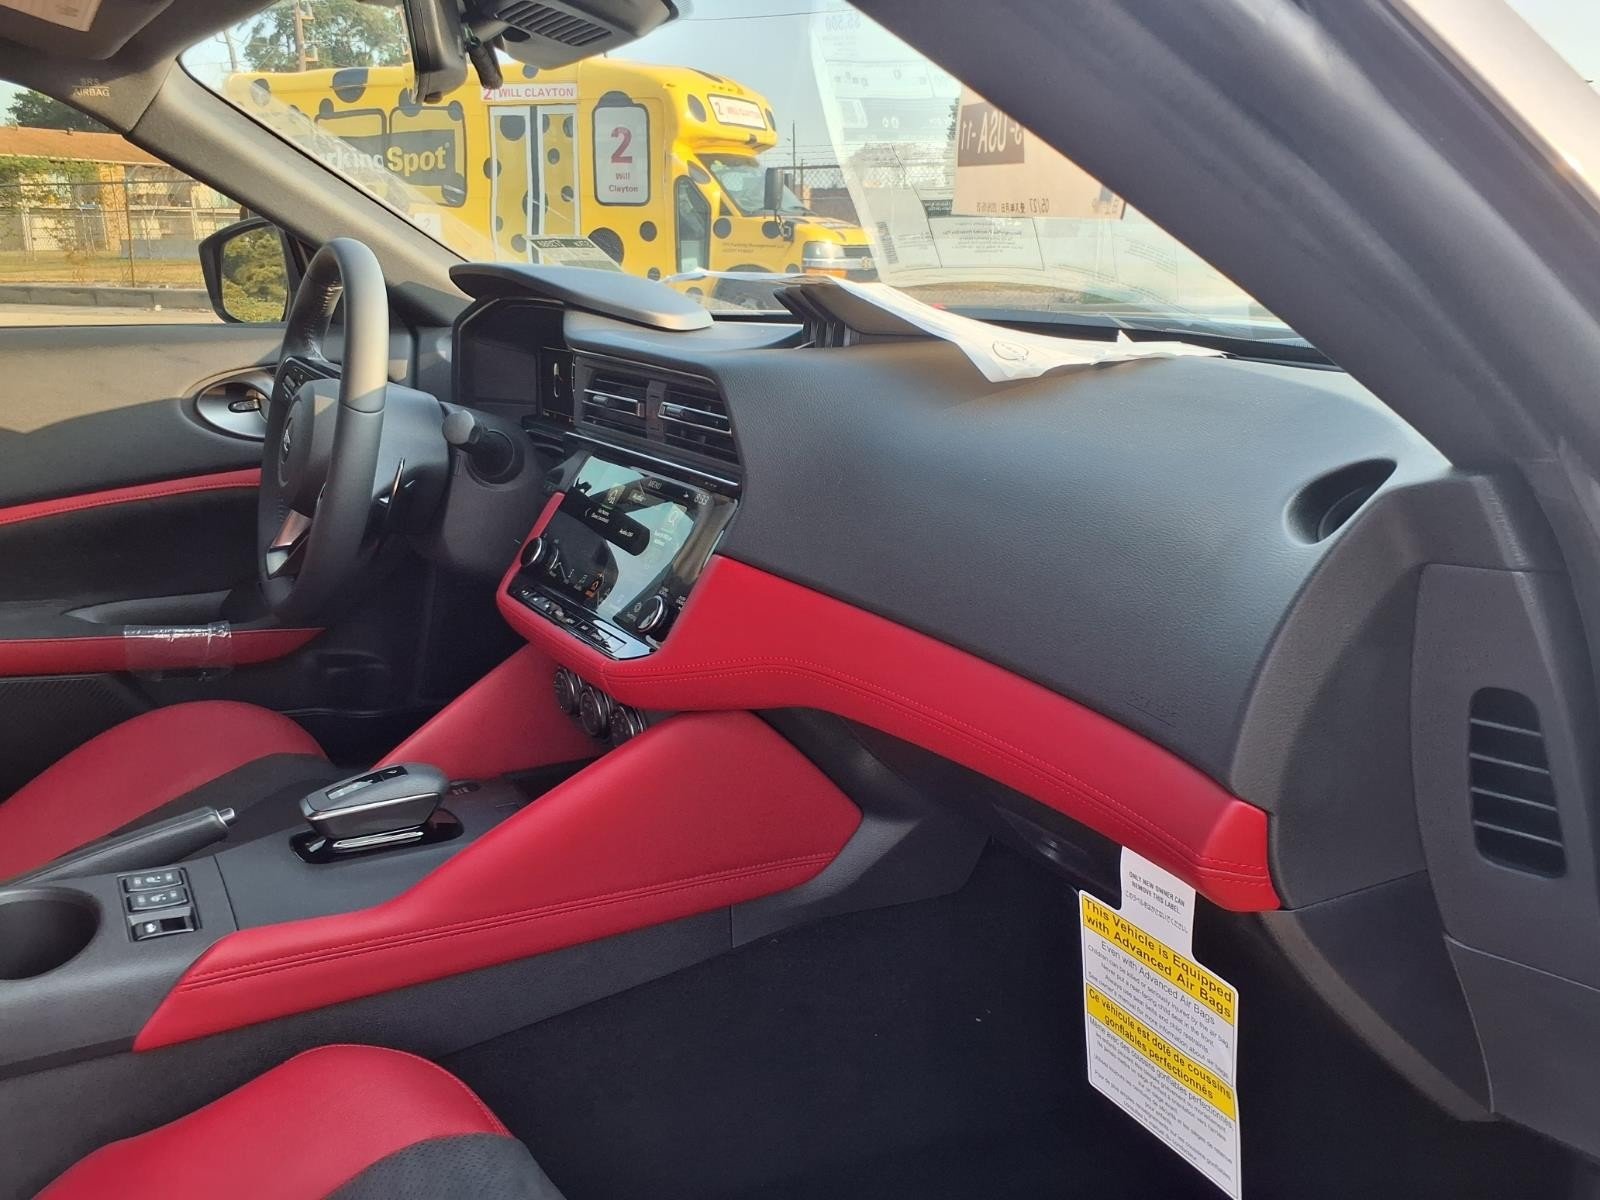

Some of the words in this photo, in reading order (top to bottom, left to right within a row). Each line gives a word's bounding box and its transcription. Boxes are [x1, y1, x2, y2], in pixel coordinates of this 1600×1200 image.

[72, 88, 110, 96] AIRBAG
[499, 88, 521, 98] WILL
[524, 87, 574, 98] CLAYTON
[386, 146, 446, 177] Spot
[610, 126, 633, 164] 2
[608, 184, 639, 193] Clayton
[615, 172, 630, 180] Will
[1142, 877, 1153, 889] NEW
[1174, 895, 1184, 907] CAN
[1084, 897, 1109, 921] This
[1112, 915, 1154, 951] Vehicle
[1158, 944, 1168, 960] is
[1173, 953, 1231, 1005] Equipped
[1086, 912, 1109, 935] with
[1113, 929, 1171, 976] Advanced
[1176, 971, 1194, 992] Air
[1199, 986, 1230, 1020] Bags
[1101, 940, 1120, 959] Even
[1122, 954, 1136, 971] with
[1139, 965, 1177, 999] Advanced
[1179, 993, 1191, 1009] Air
[1193, 1003, 1214, 1027] Bags
[1089, 987, 1099, 1003] Ce
[1101, 996, 1134, 1029] véhicule
[1137, 1023, 1150, 1041] est
[1151, 1034, 1170, 1057] doté
[1173, 1051, 1184, 1067] de
[1187, 1061, 1231, 1100] coussins
[1104, 1014, 1146, 1054] gonflables
[1149, 1045, 1213, 1102] perfectionnés
